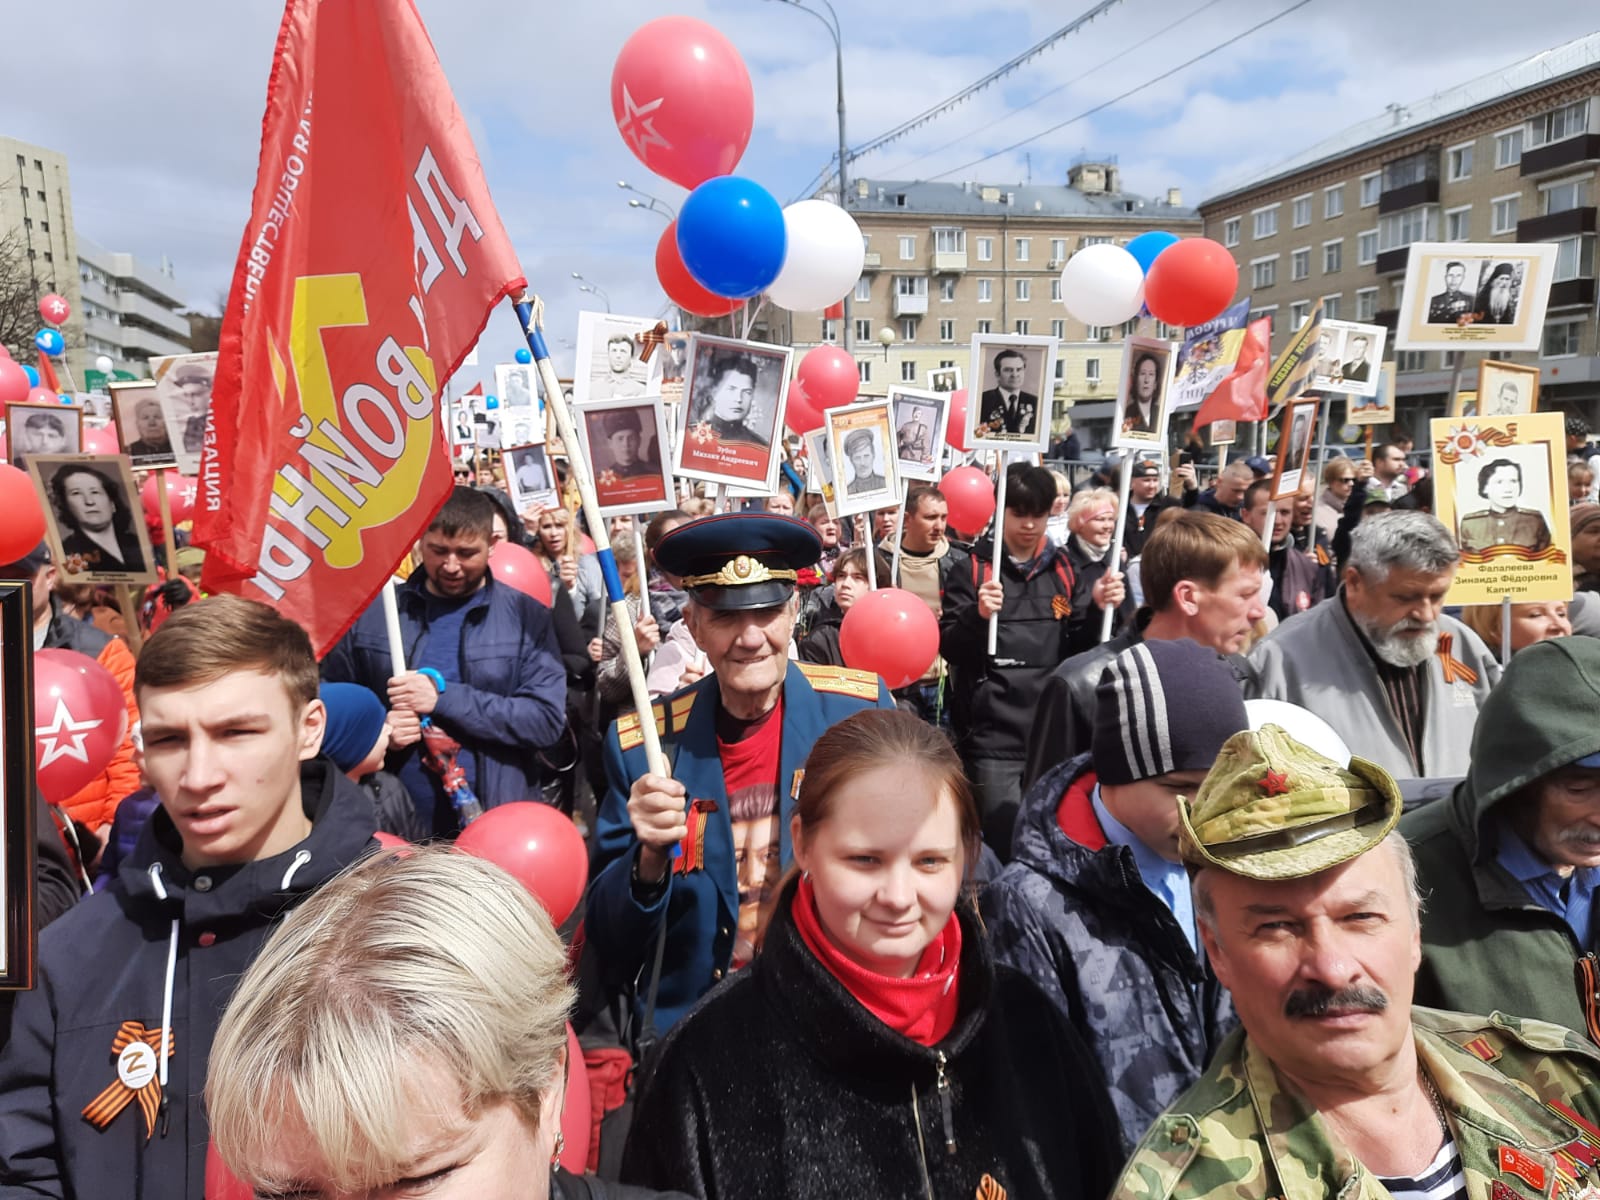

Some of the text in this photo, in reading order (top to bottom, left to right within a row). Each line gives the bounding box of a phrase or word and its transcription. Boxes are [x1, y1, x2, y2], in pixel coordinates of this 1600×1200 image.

[692, 449, 720, 461] Михаил
[1478, 564, 1534, 573] Фалалеева
[1455, 574, 1558, 585] Зинаида Фёдоровна
[122, 1051, 147, 1074] Z
